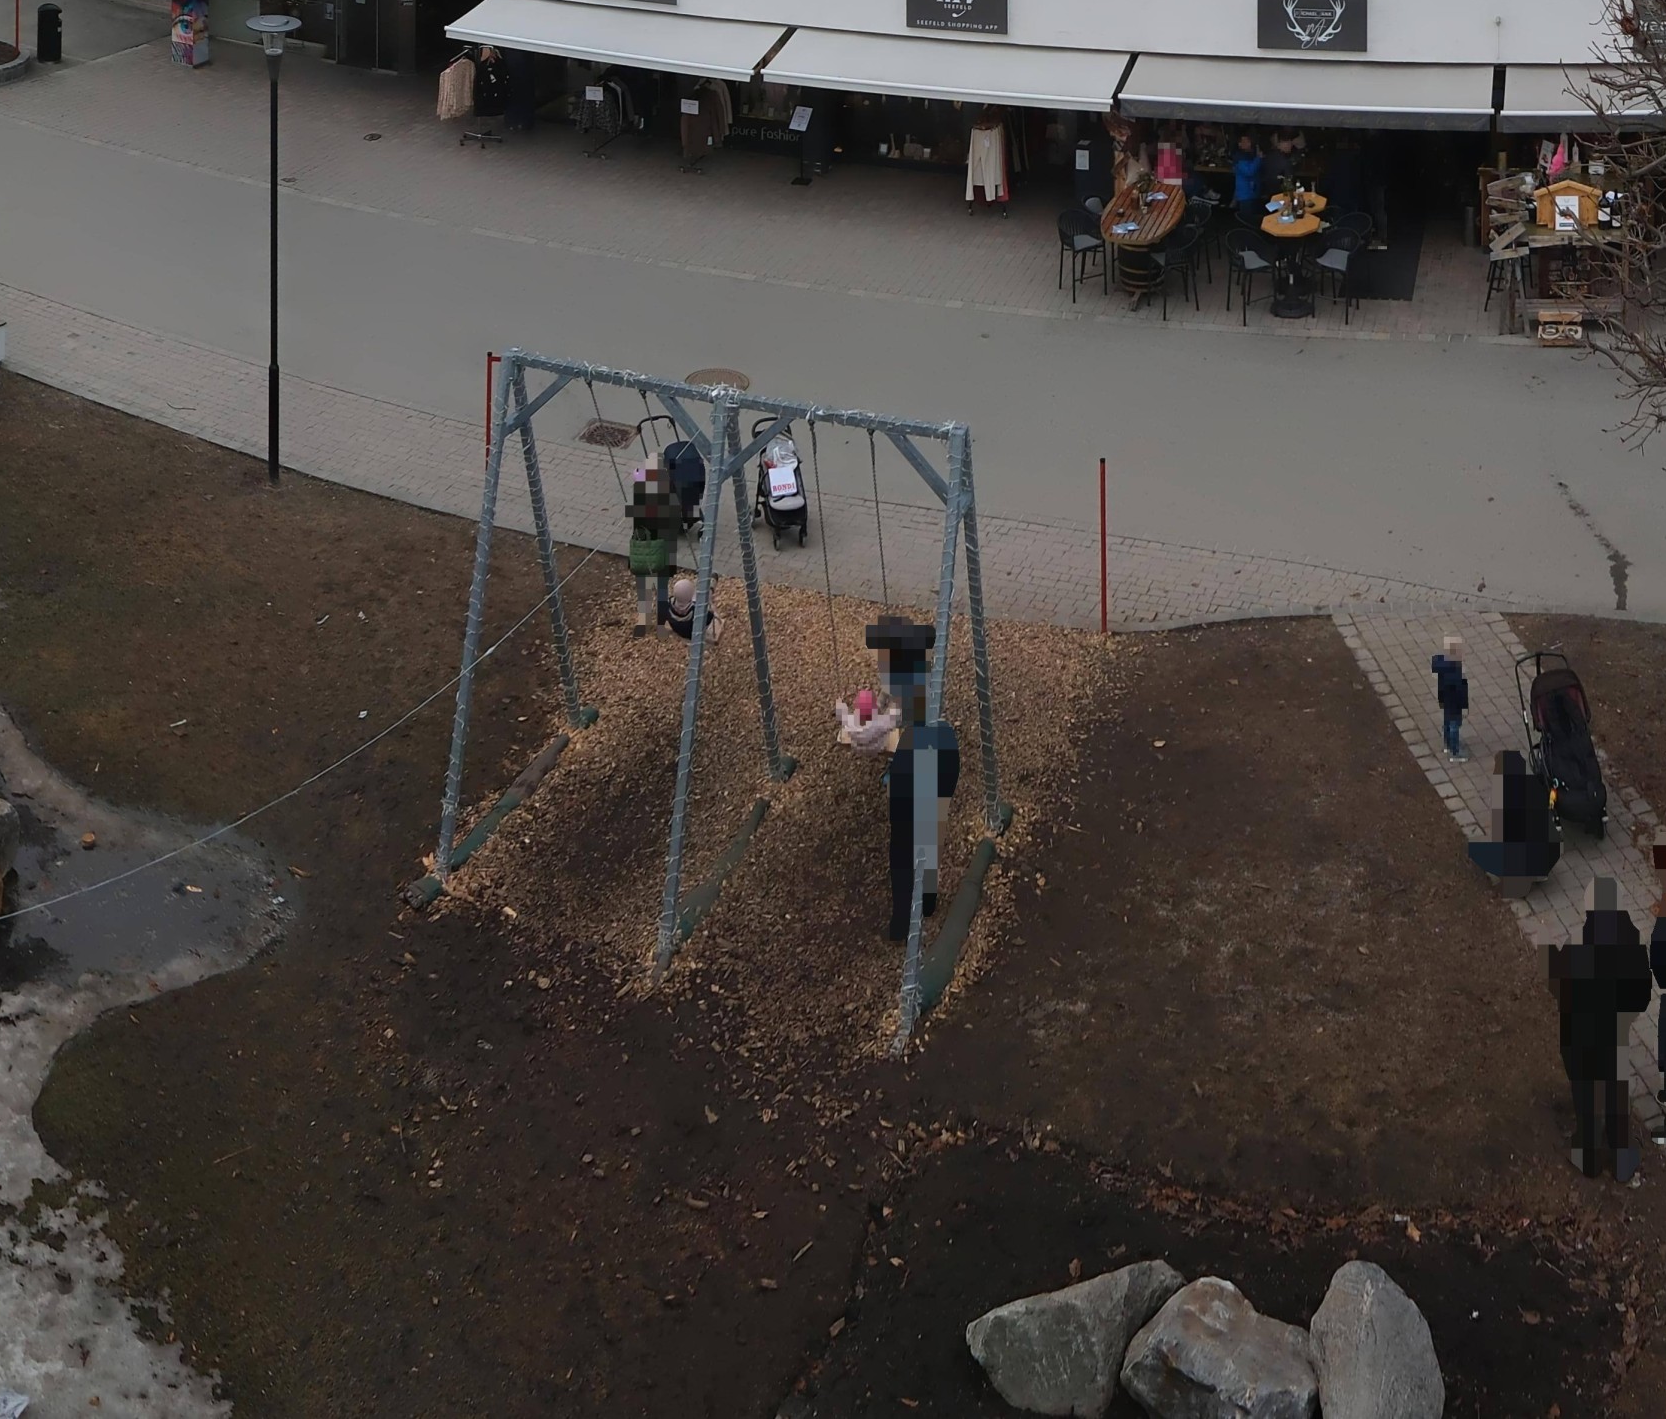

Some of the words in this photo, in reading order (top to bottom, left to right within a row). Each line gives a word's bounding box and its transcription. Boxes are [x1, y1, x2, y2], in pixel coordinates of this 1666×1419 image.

[943, 3, 973, 11] SEEFELD
[916, 19, 946, 27] SEEFELD
[947, 21, 983, 30] SHOPPING
